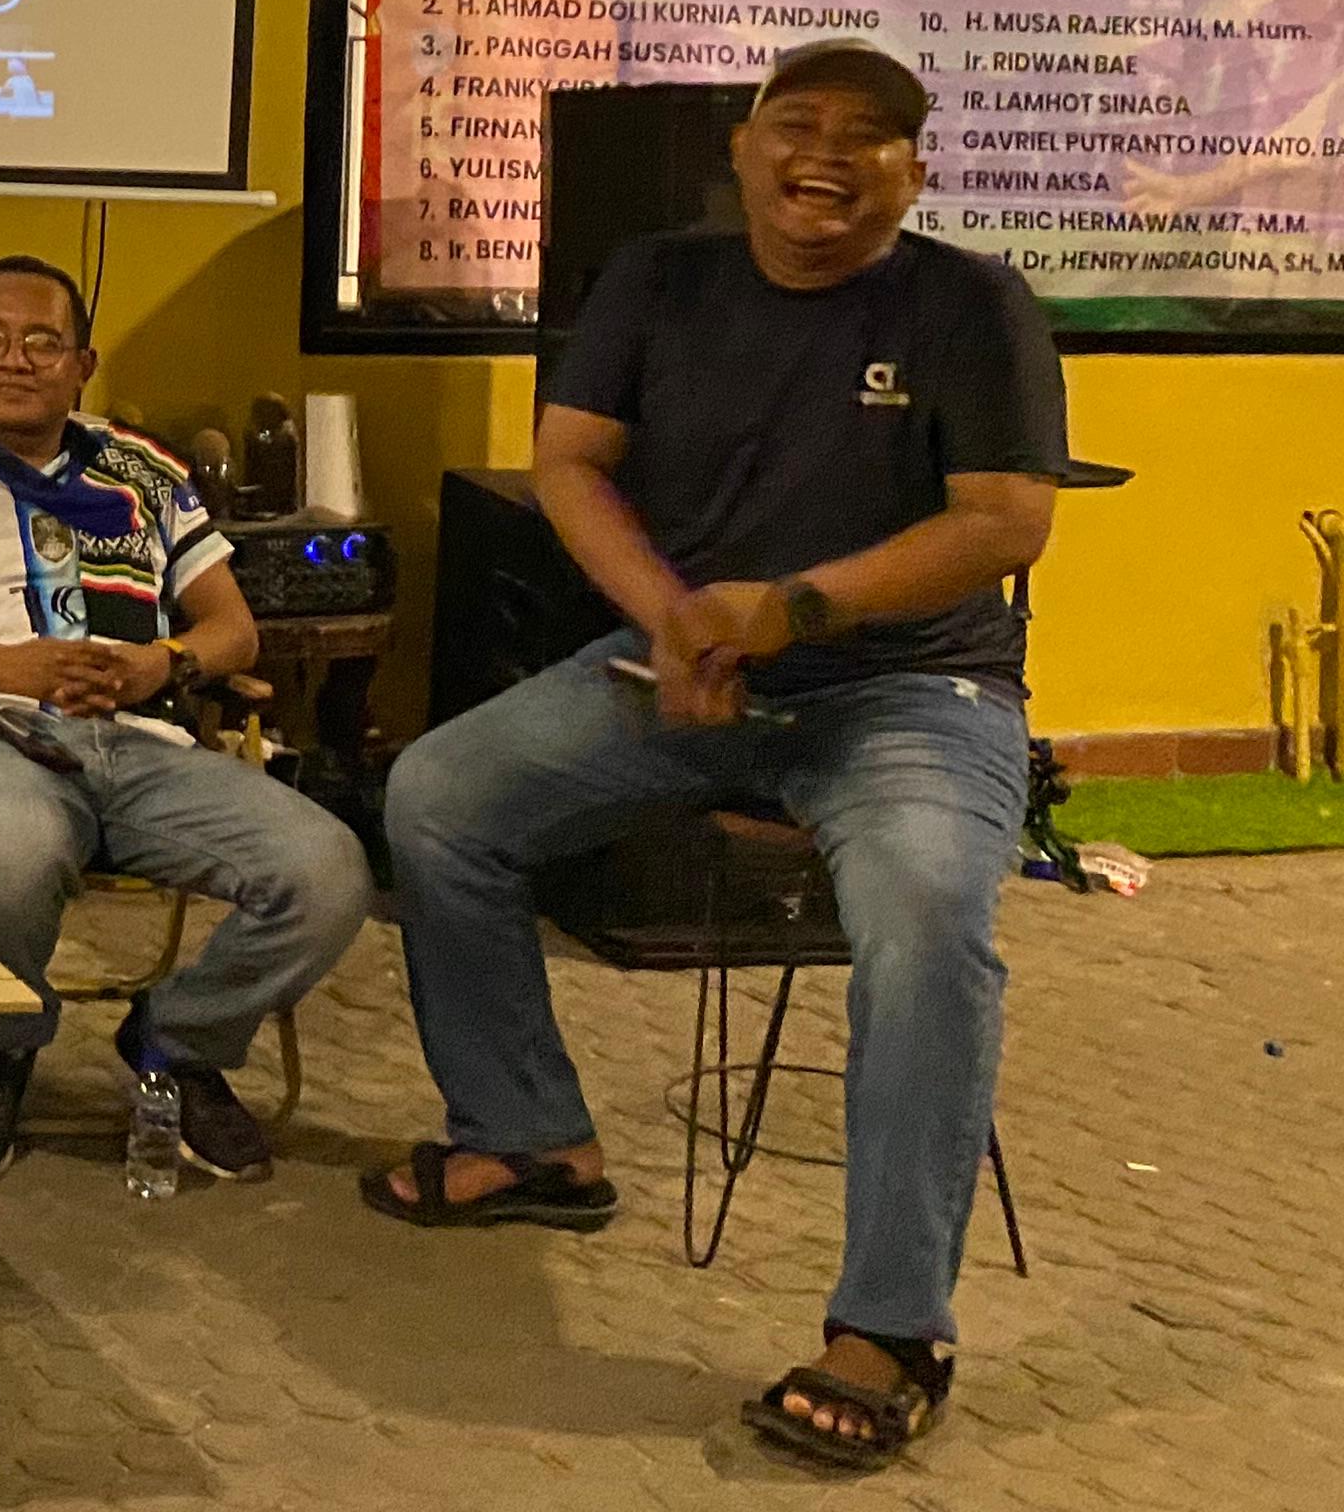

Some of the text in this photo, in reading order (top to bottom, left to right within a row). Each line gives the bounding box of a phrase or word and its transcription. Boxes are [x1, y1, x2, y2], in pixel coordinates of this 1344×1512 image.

[589, 0, 647, 23] DOLI
[653, 2, 742, 25] KURNIA
[748, 5, 880, 29] TANDJUNG
[919, 11, 1312, 41] 10. H. MUSA RAJEKSHAH, M. Hum.
[421, 35, 441, 57] 3.
[454, 35, 480, 57] Ir.
[486, 36, 612, 61] PANGGAH
[618, 41, 740, 70] SUSANTO,
[918, 50, 1138, 76] 11. Ir. RIDWAN BAE
[420, 76, 441, 97] 4.
[453, 76, 551, 98] FRANKY
[924, 90, 1192, 116] 2. IR. LAMHOT SINAGA
[420, 116, 439, 137] 5.
[963, 130, 1060, 152] GAVRIEL
[1066, 132, 1195, 155] PUTRANTO
[420, 157, 438, 179] 6.
[926, 170, 1111, 193] 4. ERWIN AKSA
[418, 199, 436, 220] 7.
[916, 211, 945, 231] 15.
[962, 210, 996, 231] Dr.
[1001, 210, 1054, 231] ERIC
[1060, 210, 1202, 236] HERMAWAN,
[419, 240, 438, 261] 8.
[449, 240, 471, 262] Ir.
[1061, 250, 1138, 271] HENRY
[1143, 251, 1279, 276] INDRAGUNA,
